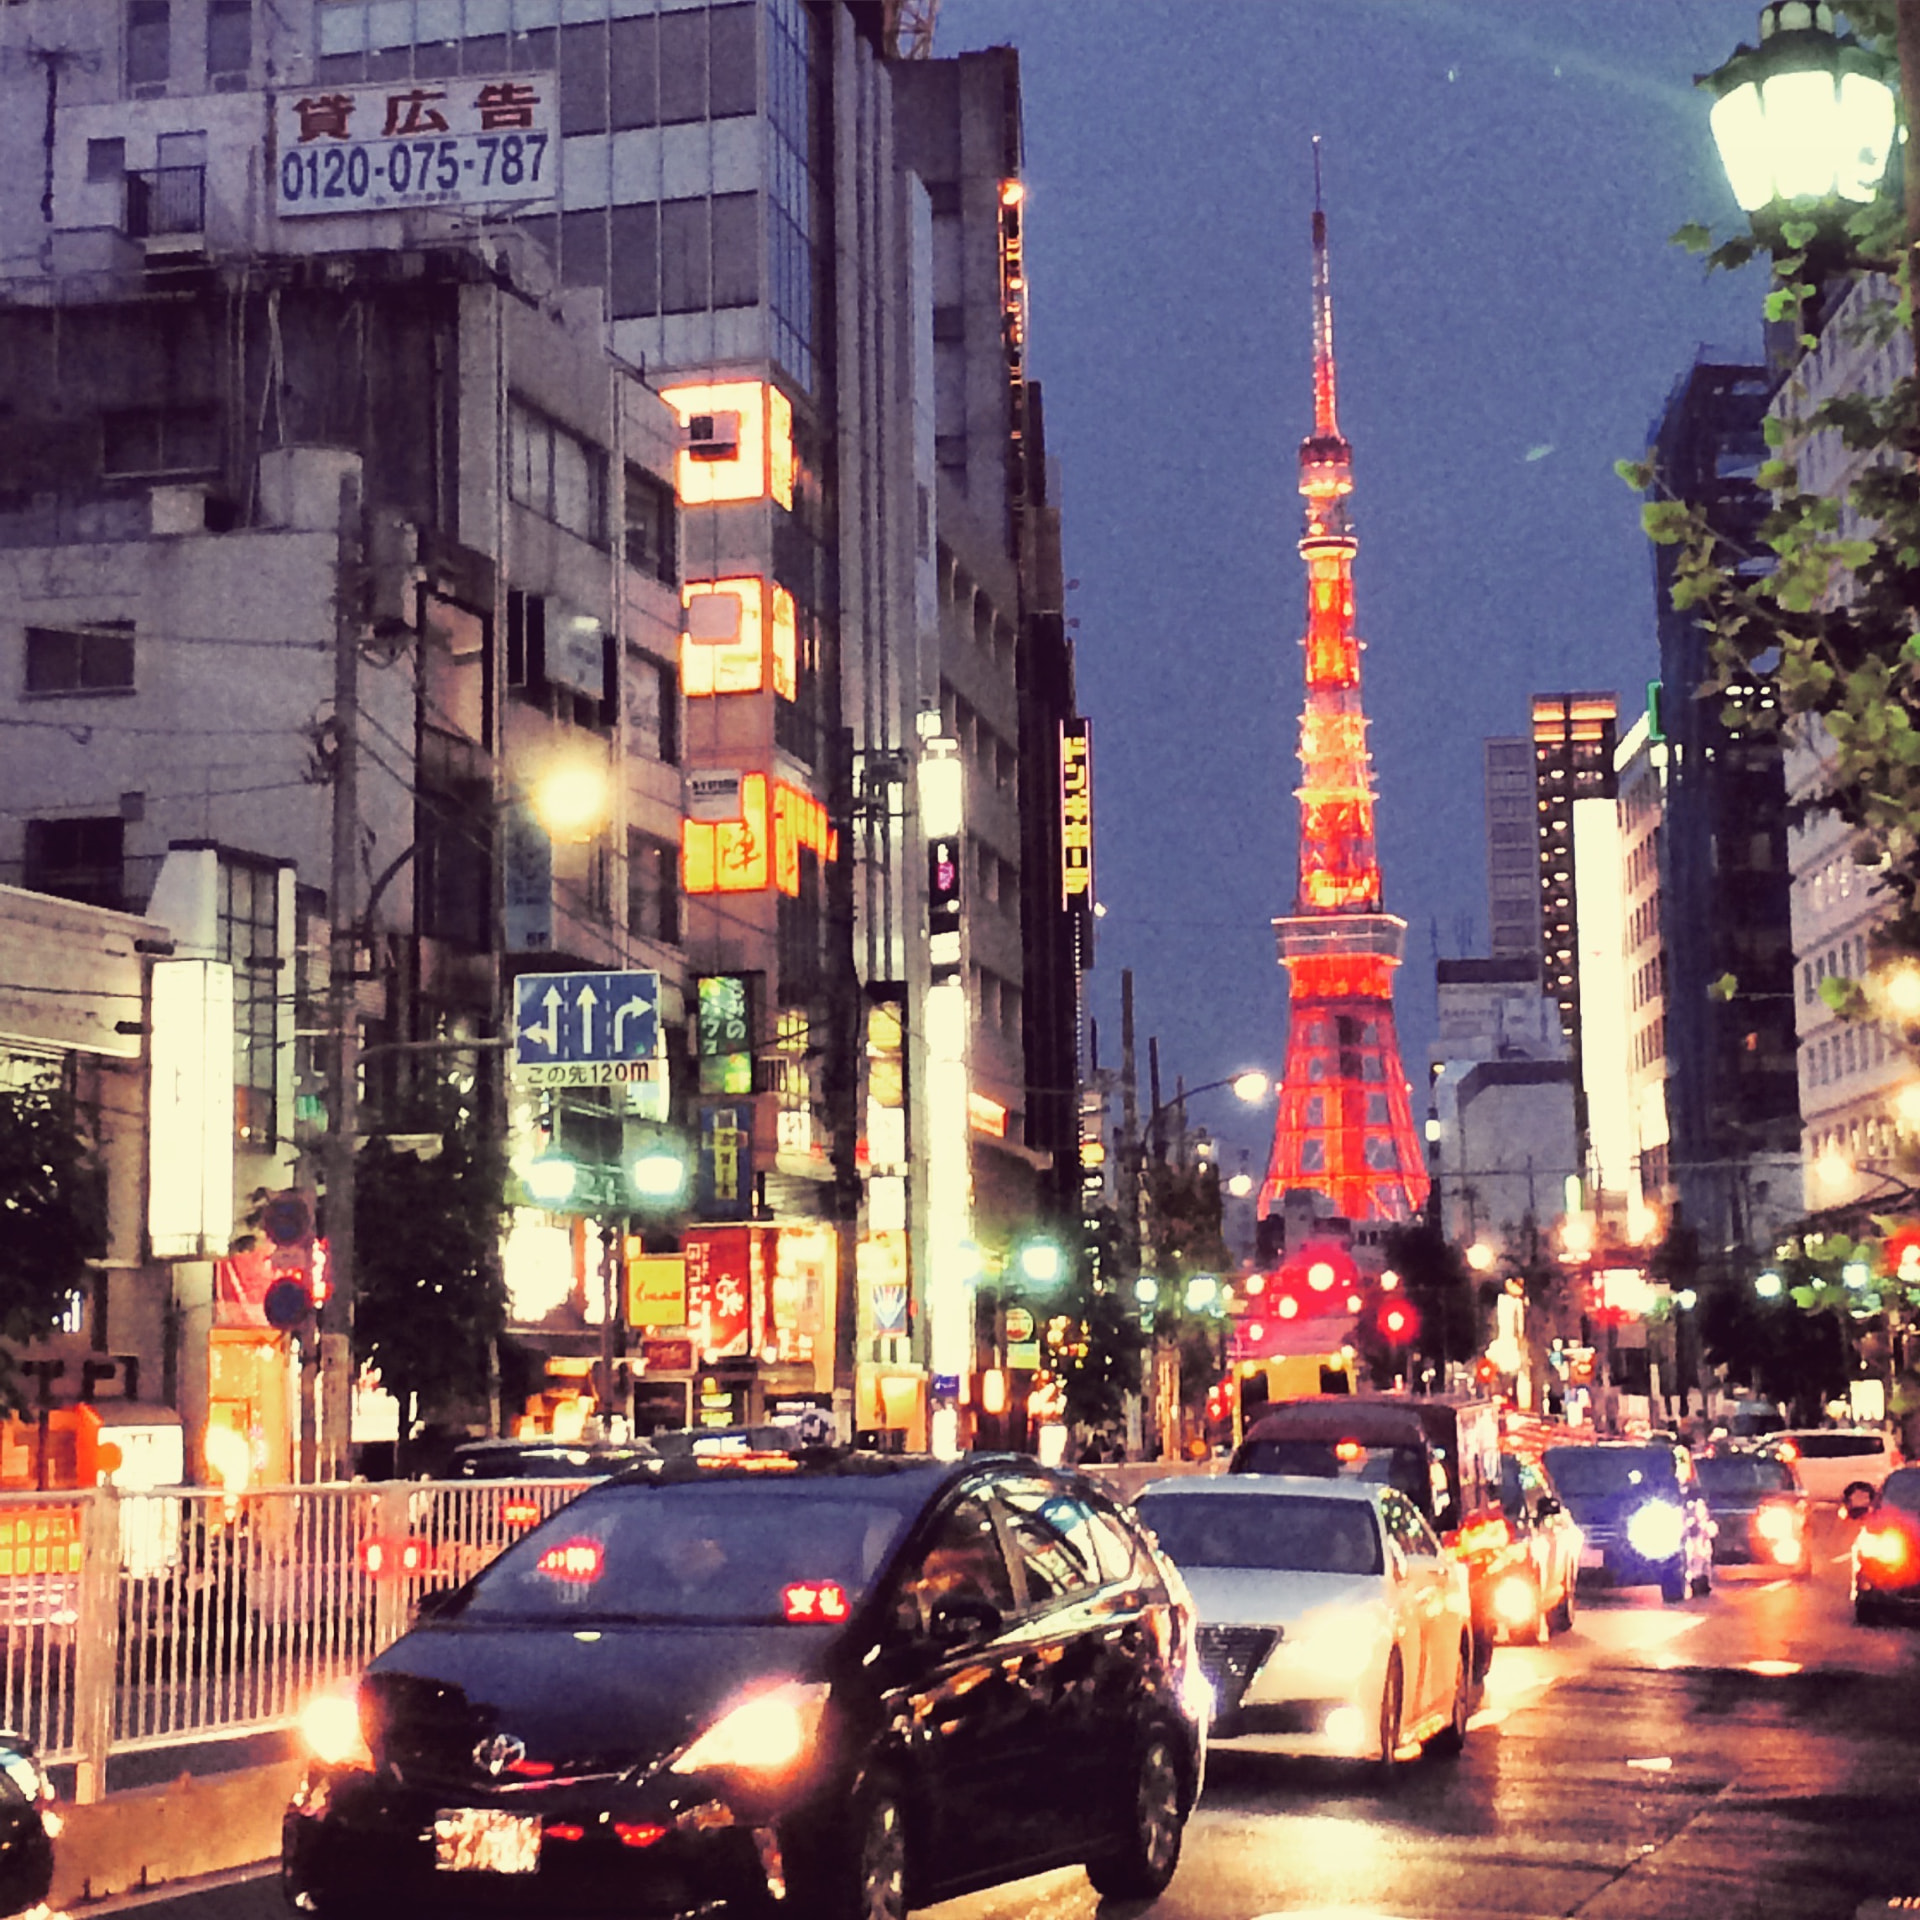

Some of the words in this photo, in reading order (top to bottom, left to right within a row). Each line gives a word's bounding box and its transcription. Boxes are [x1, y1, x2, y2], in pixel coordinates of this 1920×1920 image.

[281, 134, 548, 201] 0120-075-787
[526, 1062, 649, 1085] この先120m
